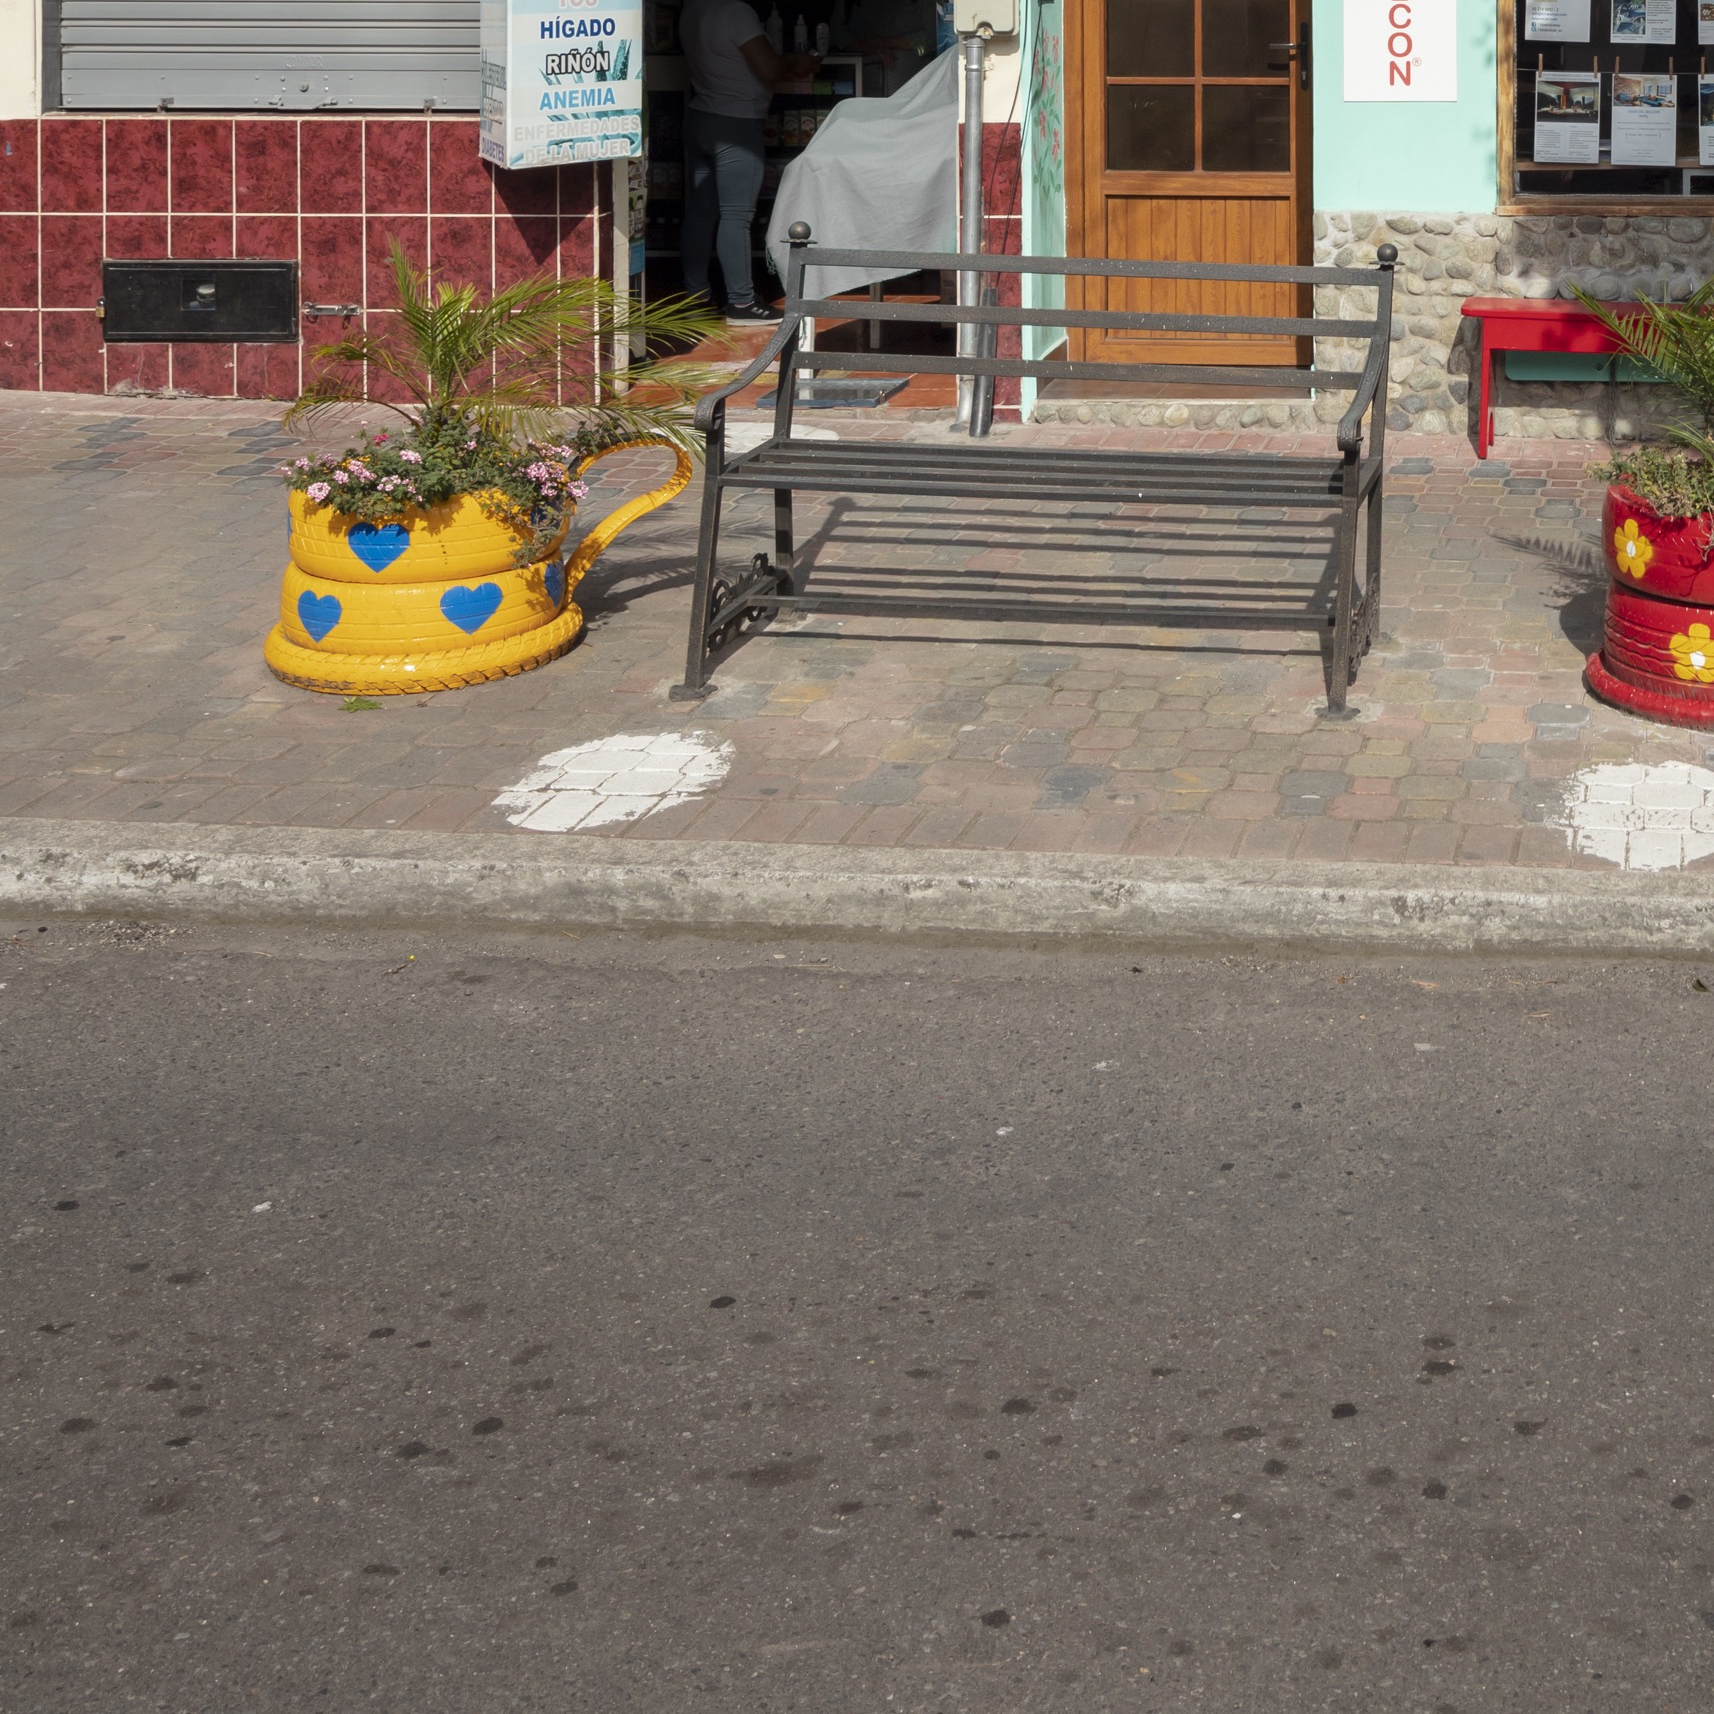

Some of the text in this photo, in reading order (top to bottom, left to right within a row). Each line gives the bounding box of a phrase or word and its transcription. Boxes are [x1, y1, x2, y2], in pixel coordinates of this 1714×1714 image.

[539, 15, 616, 39] HÍGADO
[546, 47, 610, 75] RIÑÓN
[538, 87, 616, 111] ANEMIA
[513, 116, 640, 142] ENFERMEDADES
[482, 137, 504, 164] DIABETES
[551, 143, 573, 162] LA
[575, 139, 630, 160] MUJER
